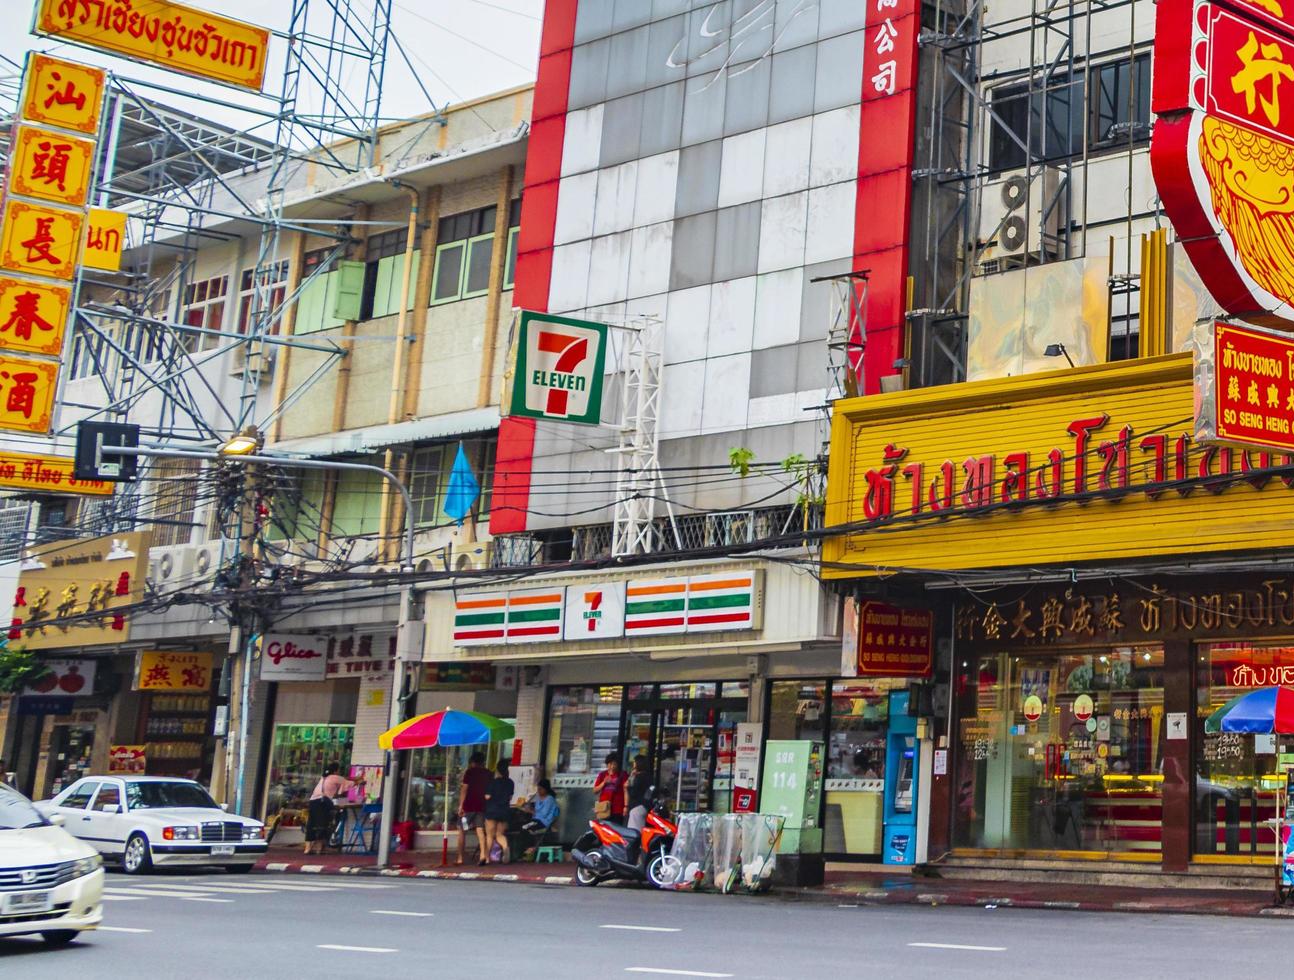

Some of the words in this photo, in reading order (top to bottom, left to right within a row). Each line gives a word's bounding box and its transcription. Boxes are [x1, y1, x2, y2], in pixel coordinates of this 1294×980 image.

[532, 369, 586, 393] ELEVEN
[1223, 408, 1237, 426] SO
[1239, 413, 1263, 432] SENG
[1265, 418, 1290, 435] HENG
[268, 641, 322, 665] Glico
